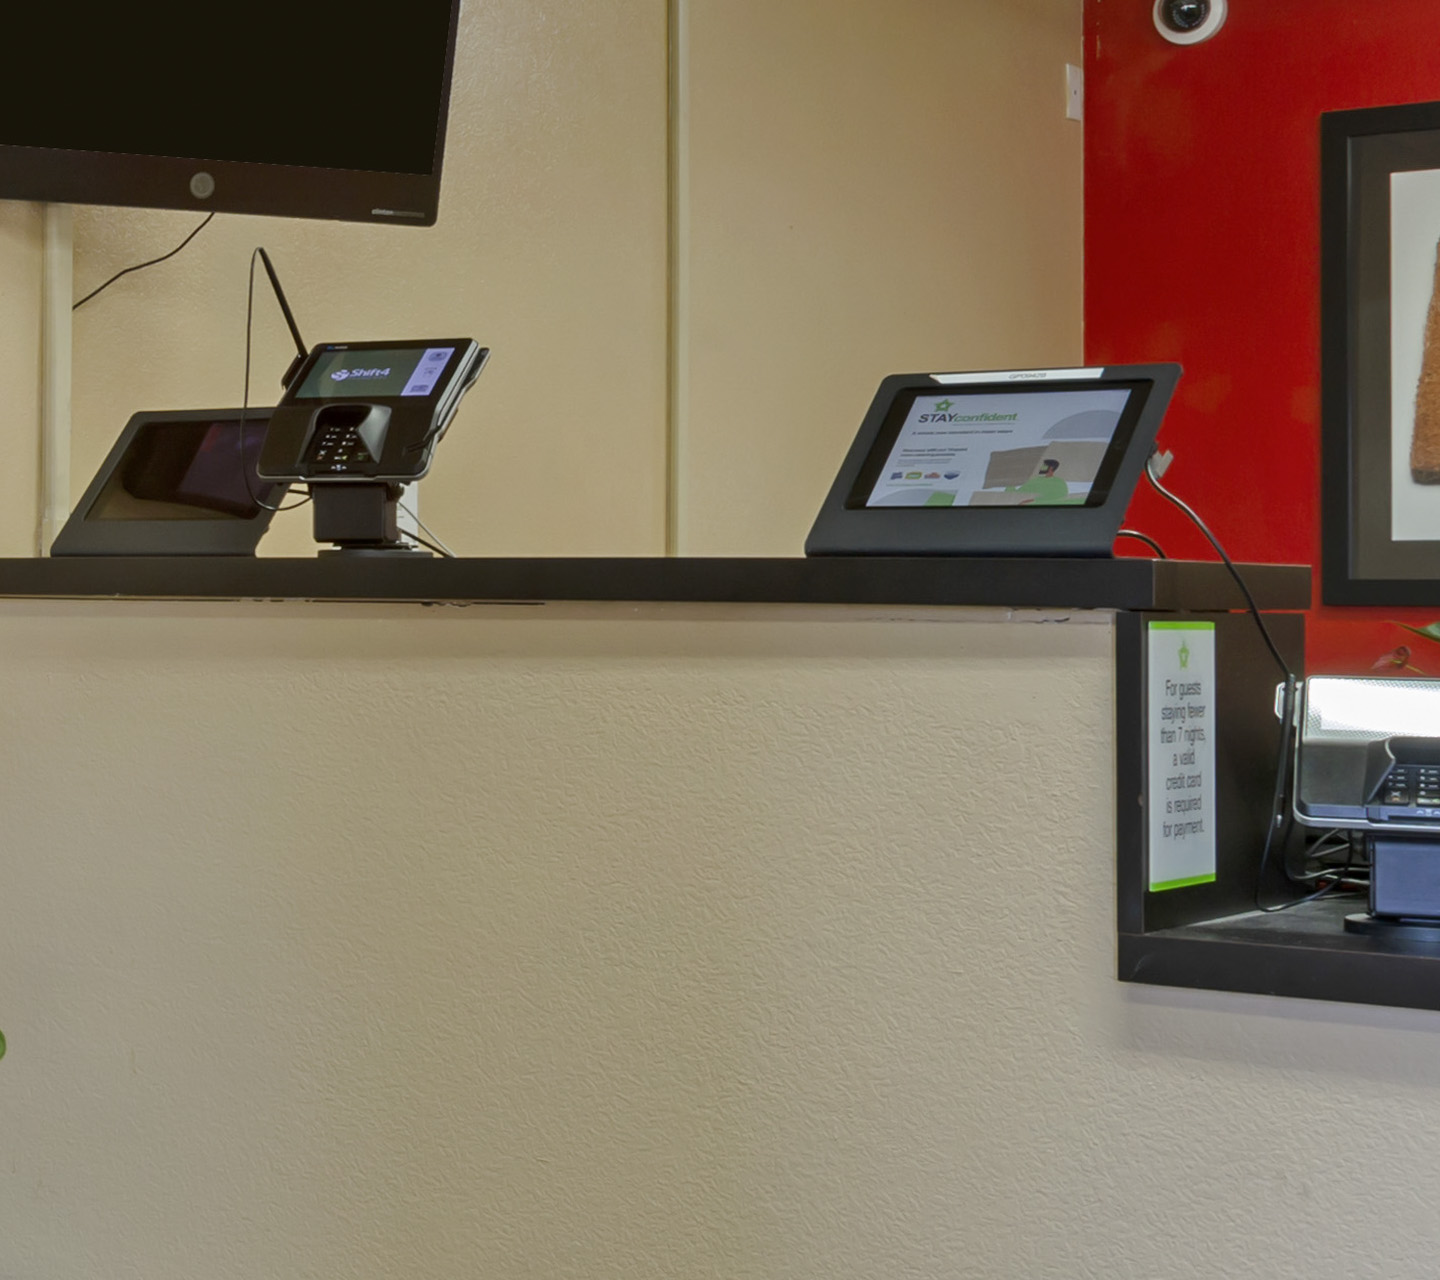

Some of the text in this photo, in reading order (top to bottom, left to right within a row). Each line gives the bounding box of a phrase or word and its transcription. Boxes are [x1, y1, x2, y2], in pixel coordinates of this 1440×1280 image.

[350, 367, 391, 377] Shift4
[1165, 679, 1202, 701] For guests
[1161, 701, 1207, 725] staying fewer
[1160, 726, 1176, 744] than
[1177, 726, 1183, 743] 7
[1172, 747, 1196, 767] a valid
[1165, 770, 1202, 791] credit card
[1166, 793, 1202, 816] is required
[1163, 820, 1173, 838] for
